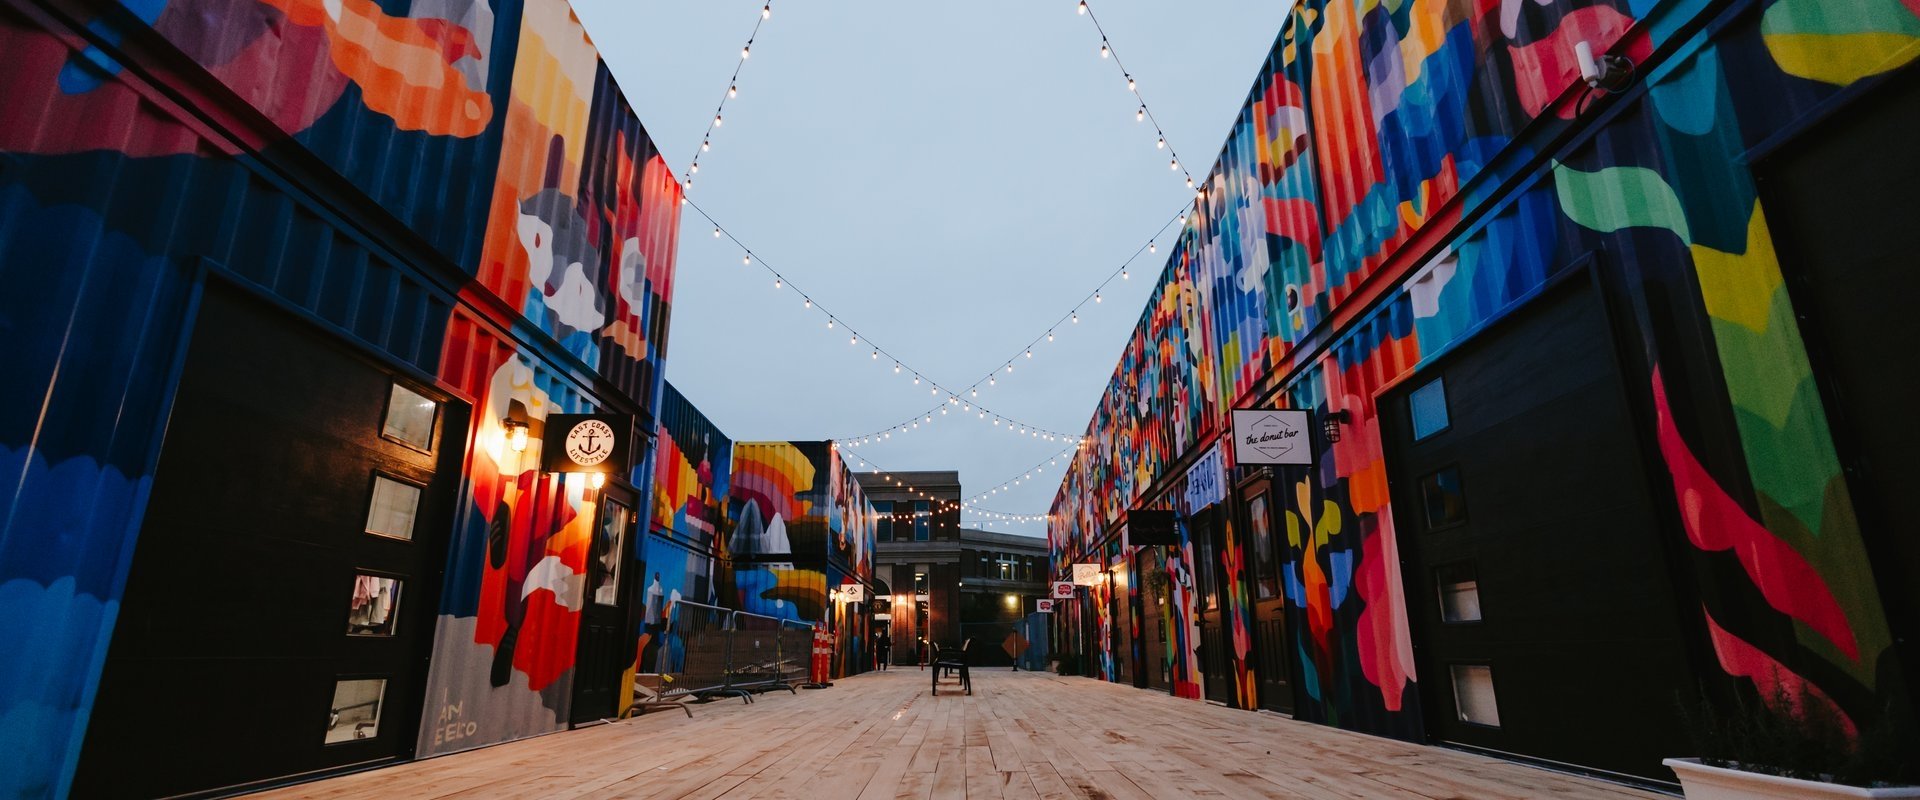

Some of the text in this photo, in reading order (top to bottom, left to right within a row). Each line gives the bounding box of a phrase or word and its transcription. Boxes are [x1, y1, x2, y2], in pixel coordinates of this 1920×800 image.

[570, 422, 611, 439] EAST COAST
[1246, 427, 1299, 445] the donut bar
[569, 448, 608, 464] LIFESTYLE
[438, 700, 463, 723] AM
